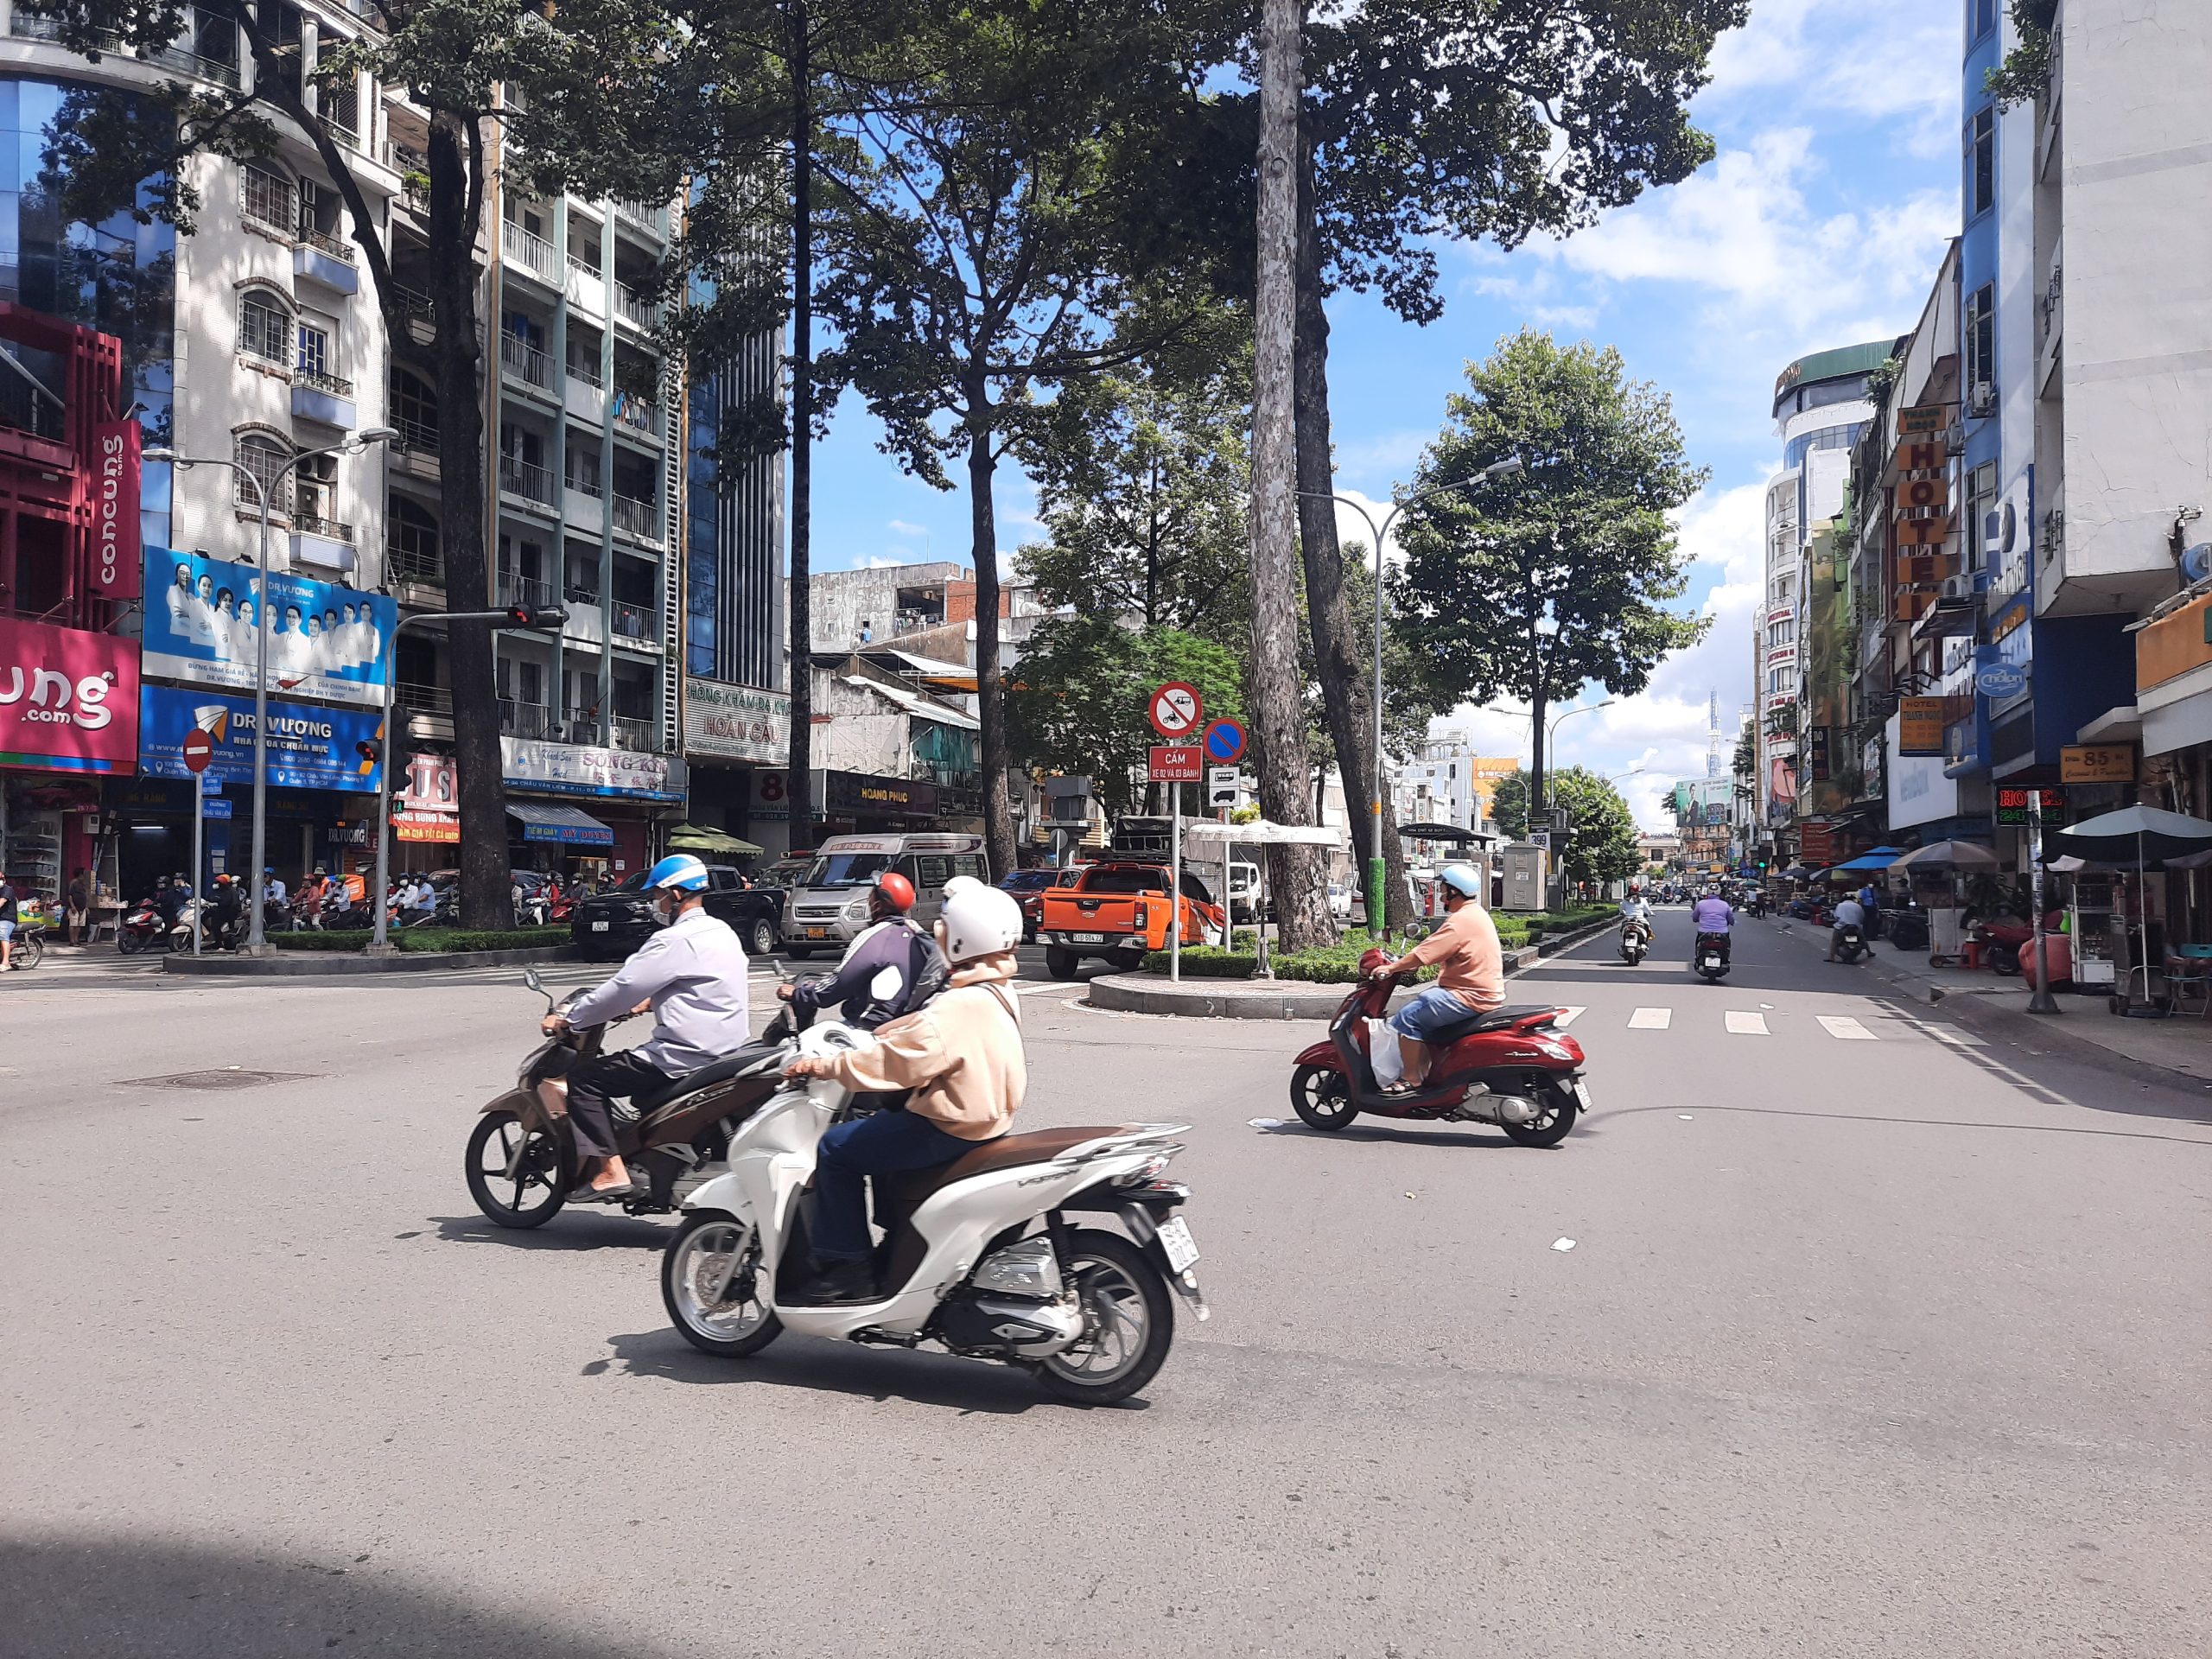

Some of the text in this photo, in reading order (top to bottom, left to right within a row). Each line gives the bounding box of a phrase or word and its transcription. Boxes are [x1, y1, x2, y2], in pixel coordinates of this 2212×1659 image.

[101, 434, 124, 584] concung
[773, 699, 792, 716] KHO
[22, 709, 71, 724] .com
[1165, 749, 1185, 765] CẤM
[2084, 751, 2108, 766] 85
[1152, 766, 1198, 778] XE 02 VÀ 03 BÁNH
[1999, 790, 2062, 807] HOEL
[1531, 835, 1547, 845] 399
